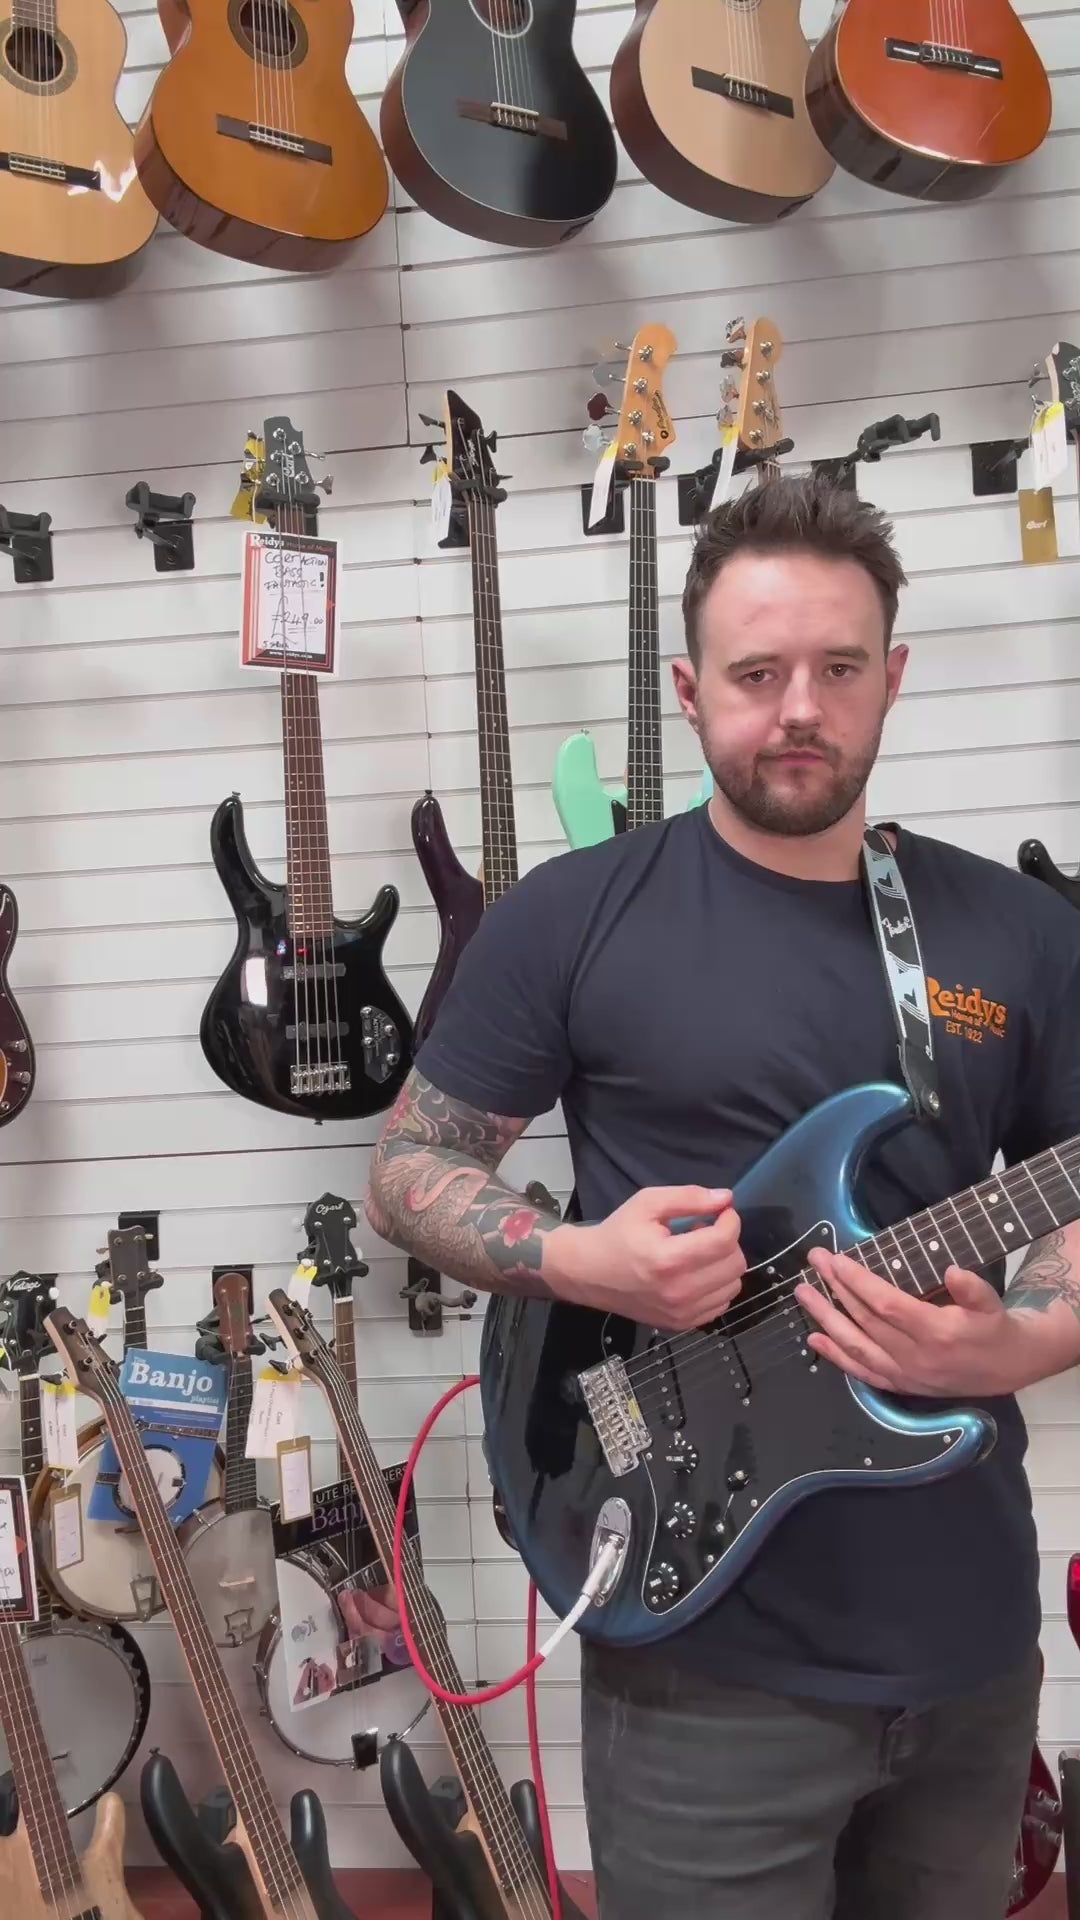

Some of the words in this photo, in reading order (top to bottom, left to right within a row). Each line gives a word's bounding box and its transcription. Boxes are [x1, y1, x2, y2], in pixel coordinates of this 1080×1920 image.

[251, 533, 285, 548] Reidys
[926, 976, 1007, 1026] Reidys
[127, 1361, 213, 1397] Banjo
